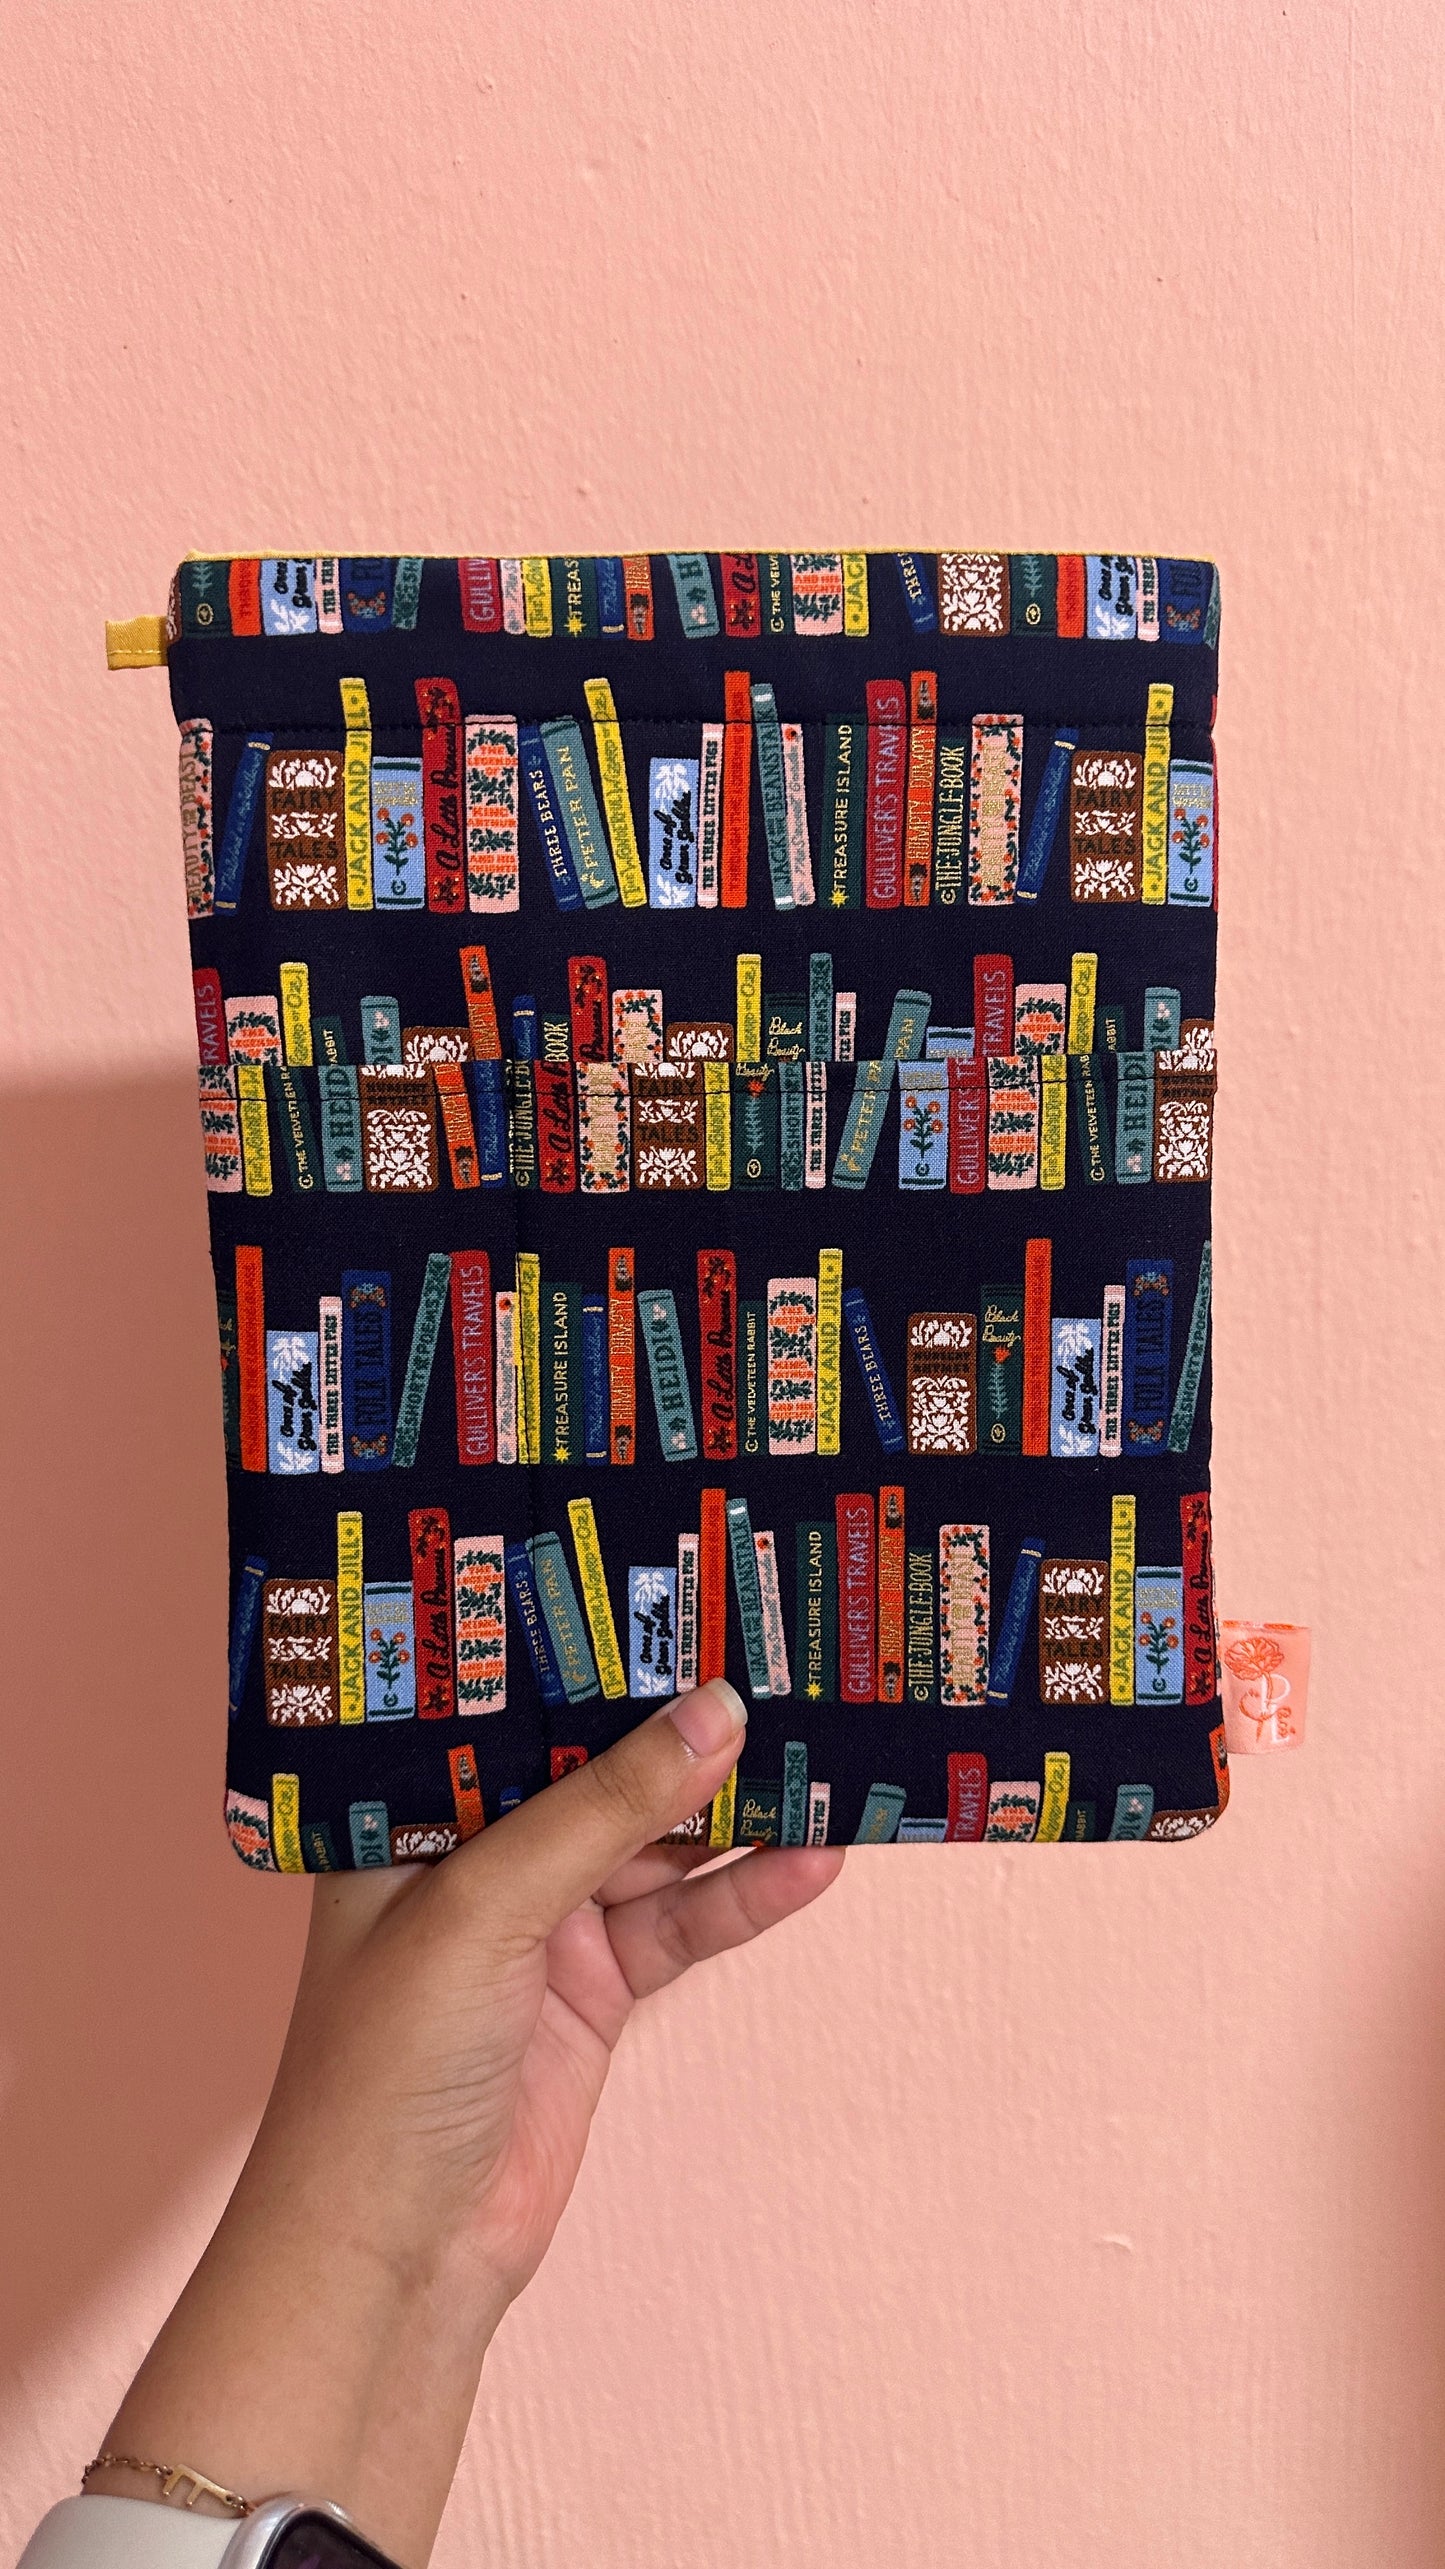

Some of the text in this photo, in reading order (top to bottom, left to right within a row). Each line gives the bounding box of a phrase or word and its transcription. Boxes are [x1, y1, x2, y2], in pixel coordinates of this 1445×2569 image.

[322, 589, 336, 614] THE
[771, 591, 781, 615] THE
[1142, 599, 1155, 624] THE
[467, 757, 518, 766] LEGENDS
[480, 746, 505, 755] THE
[271, 789, 337, 809] FAIRY
[471, 806, 510, 817] KING
[557, 746, 599, 868] PETER PAN
[834, 724, 853, 891] TREASURE ISLAND
[1076, 789, 1136, 807] FAIRY
[1146, 762, 1166, 815] AND
[348, 759, 368, 886] JACK AND
[529, 769, 568, 878] THREE BEARS
[702, 741, 718, 890] THE THREE LITTLE PIGS
[935, 746, 965, 890] THE JUNGLE BOOK
[270, 842, 339, 859] TALES
[470, 854, 516, 864] AND HIS
[772, 833, 792, 885] JACK
[873, 795, 899, 899] GULLIVER'S
[1073, 838, 1136, 855] TALES
[1146, 821, 1164, 880] JACK
[543, 1021, 569, 1062] BOOK
[767, 1037, 806, 1059] Beauty
[769, 1016, 802, 1035] Black
[1124, 1054, 1147, 1131] HEIDI
[296, 1150, 308, 1173] THE
[641, 1126, 699, 1144] TALES
[810, 1107, 823, 1171] THE THREE
[1090, 1142, 1102, 1166] THE
[983, 1325, 1022, 1348] Beauty
[985, 1304, 1020, 1323] Black
[460, 1265, 489, 1454] GULLIVER'S TRAVELS
[553, 1291, 570, 1446] TREASURE ISLAND
[652, 1335, 683, 1411] HEIDI
[746, 1311, 757, 1438] THE VELVETEEN RABBIT
[821, 1274, 839, 1435] JACK AND JILL
[854, 1325, 892, 1422] THREE BEARS
[1105, 1302, 1120, 1440] THE THREE LITTLE PIGS
[325, 1314, 340, 1456] THE THREE LITTLE PIGS
[269, 1614, 331, 1634] FAIRY
[340, 1538, 361, 1702] JACK AND JILL
[515, 1580, 551, 1673] THREE BEARS
[681, 1550, 695, 1679] THE THREE LITTLE PIGS
[808, 1531, 823, 1684] TREASURE ISLAND
[846, 1507, 870, 1695] GULLIVER'S TRAVELS
[908, 1552, 934, 1687] THE JUNGLE BOOK
[1045, 1594, 1102, 1613] FAIRY
[1113, 1520, 1132, 1683] JACK AND JILL
[269, 1661, 331, 1680] TALES
[1044, 1641, 1101, 1659] TALES
[743, 1799, 777, 1819] Black
